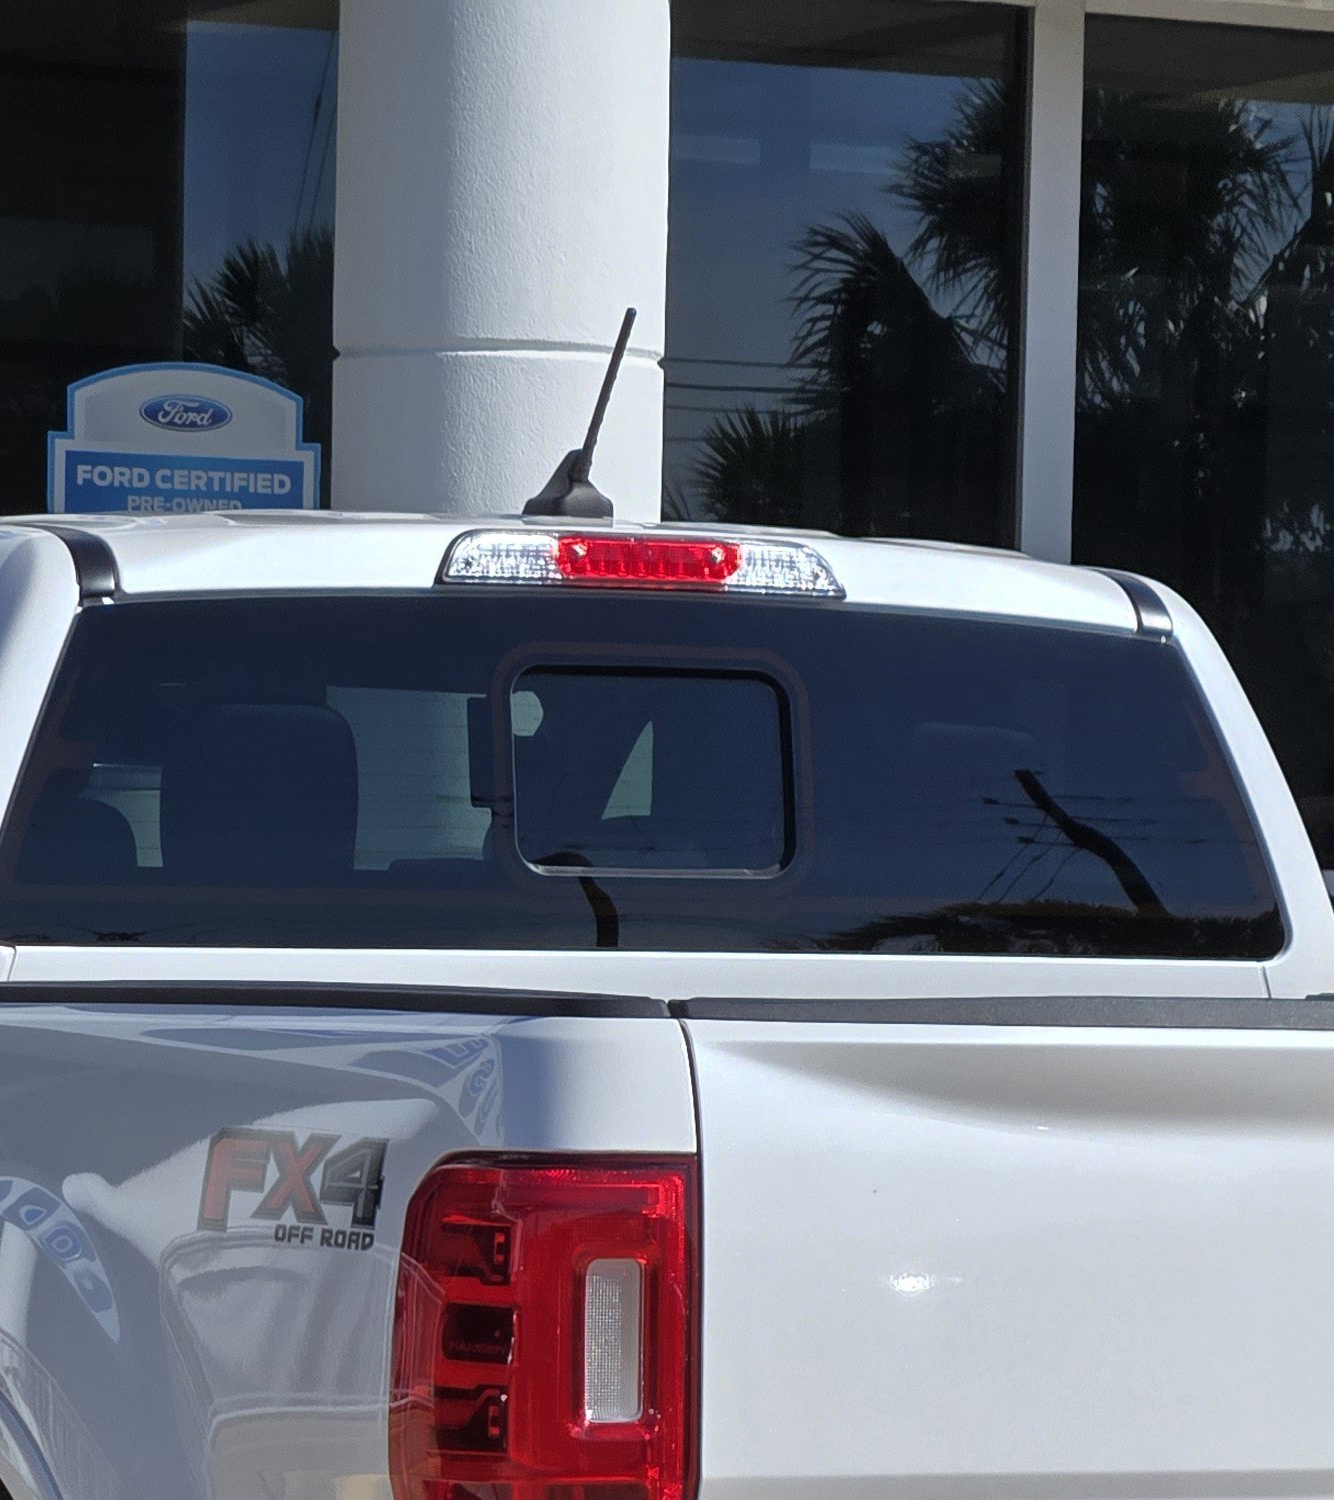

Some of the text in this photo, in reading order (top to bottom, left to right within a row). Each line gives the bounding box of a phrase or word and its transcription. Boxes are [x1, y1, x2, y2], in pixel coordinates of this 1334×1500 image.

[157, 400, 212, 426] Ford
[77, 465, 291, 495] FORD CERTIFIED
[197, 1126, 390, 1232] FX4
[274, 1224, 375, 1251] OFF ROAD
